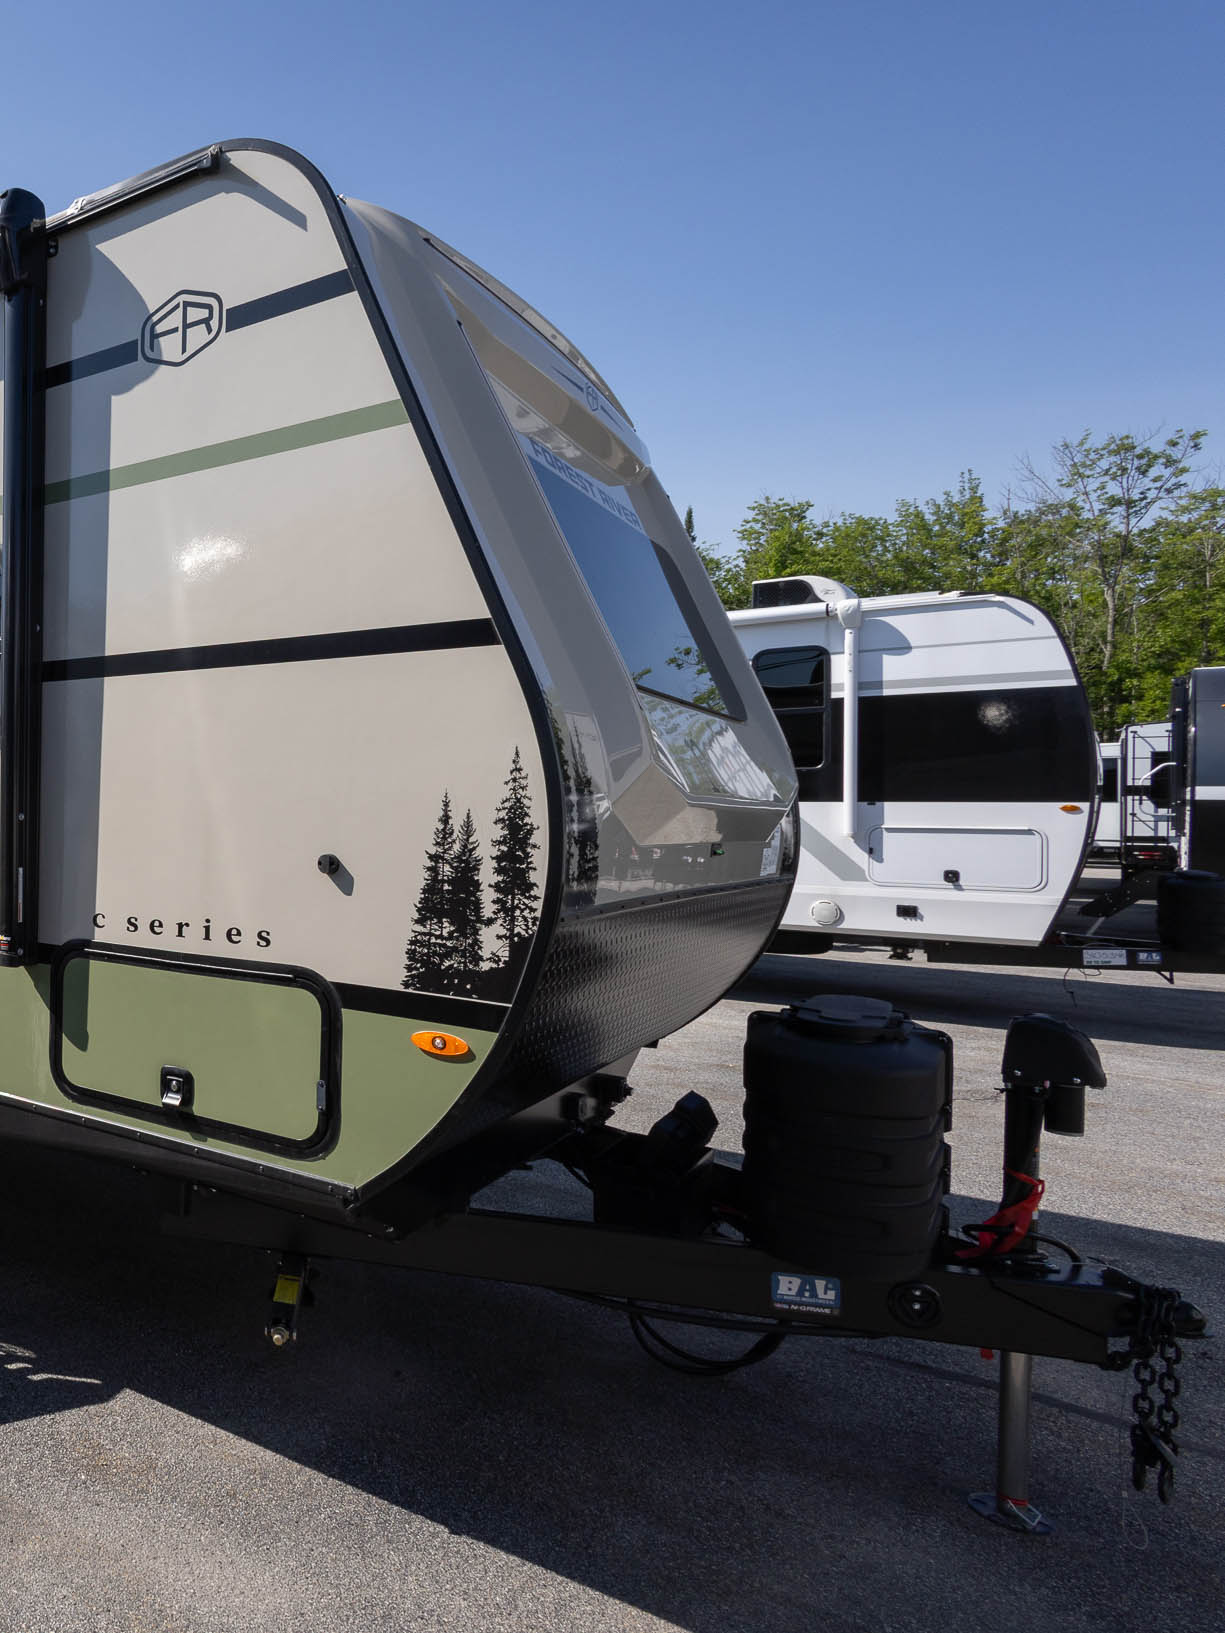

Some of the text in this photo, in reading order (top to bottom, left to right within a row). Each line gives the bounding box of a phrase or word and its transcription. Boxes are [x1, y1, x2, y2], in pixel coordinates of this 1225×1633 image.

[529, 438, 643, 531] FOREST RIVER
[92, 912, 272, 948] c series
[777, 1275, 836, 1300] BAL
